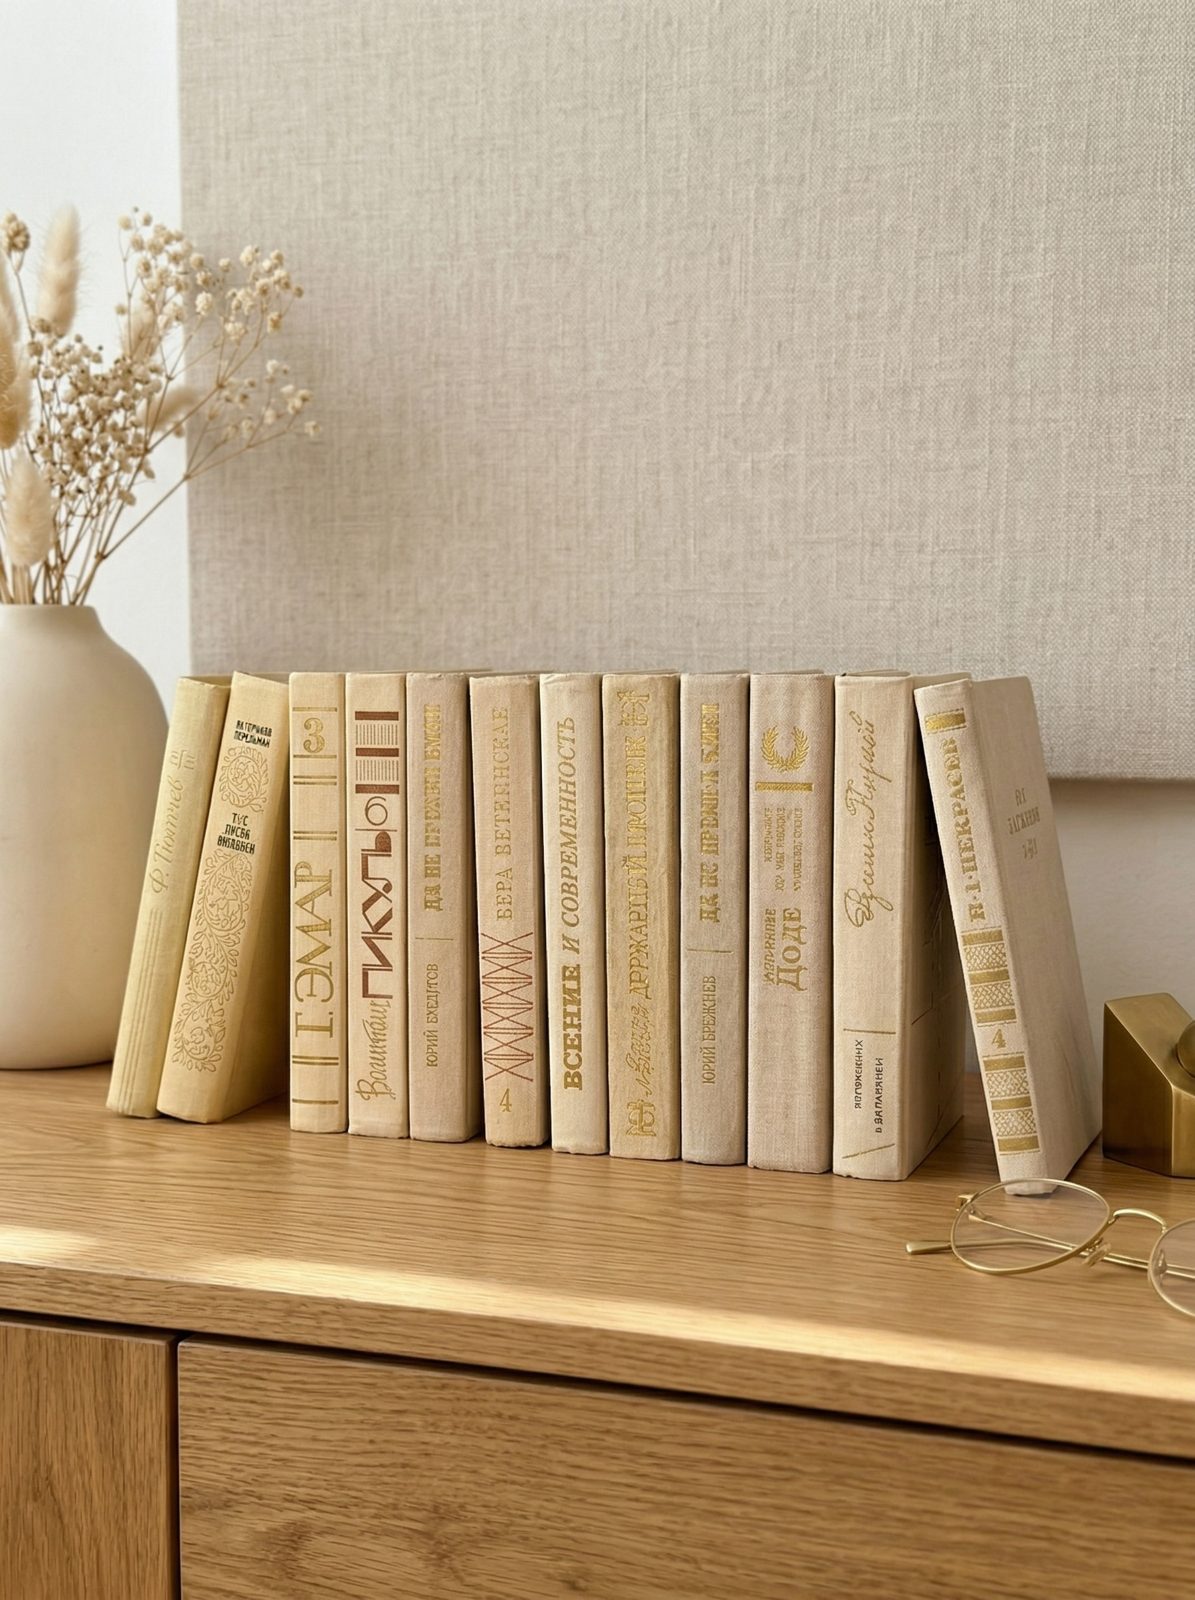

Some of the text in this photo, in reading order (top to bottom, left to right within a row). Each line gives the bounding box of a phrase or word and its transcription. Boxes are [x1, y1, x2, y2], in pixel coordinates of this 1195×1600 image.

[557, 717, 580, 928] СОВРЕМЕННОСТЬ
[294, 861, 334, 1003] ЭМАР
[361, 830, 393, 999] ПИКУЛЬ
[563, 934, 580, 955] И
[423, 1028, 439, 1068] ЮРИЙ
[991, 1026, 1007, 1049] 4
[699, 1046, 716, 1085] ЮРИЙ
